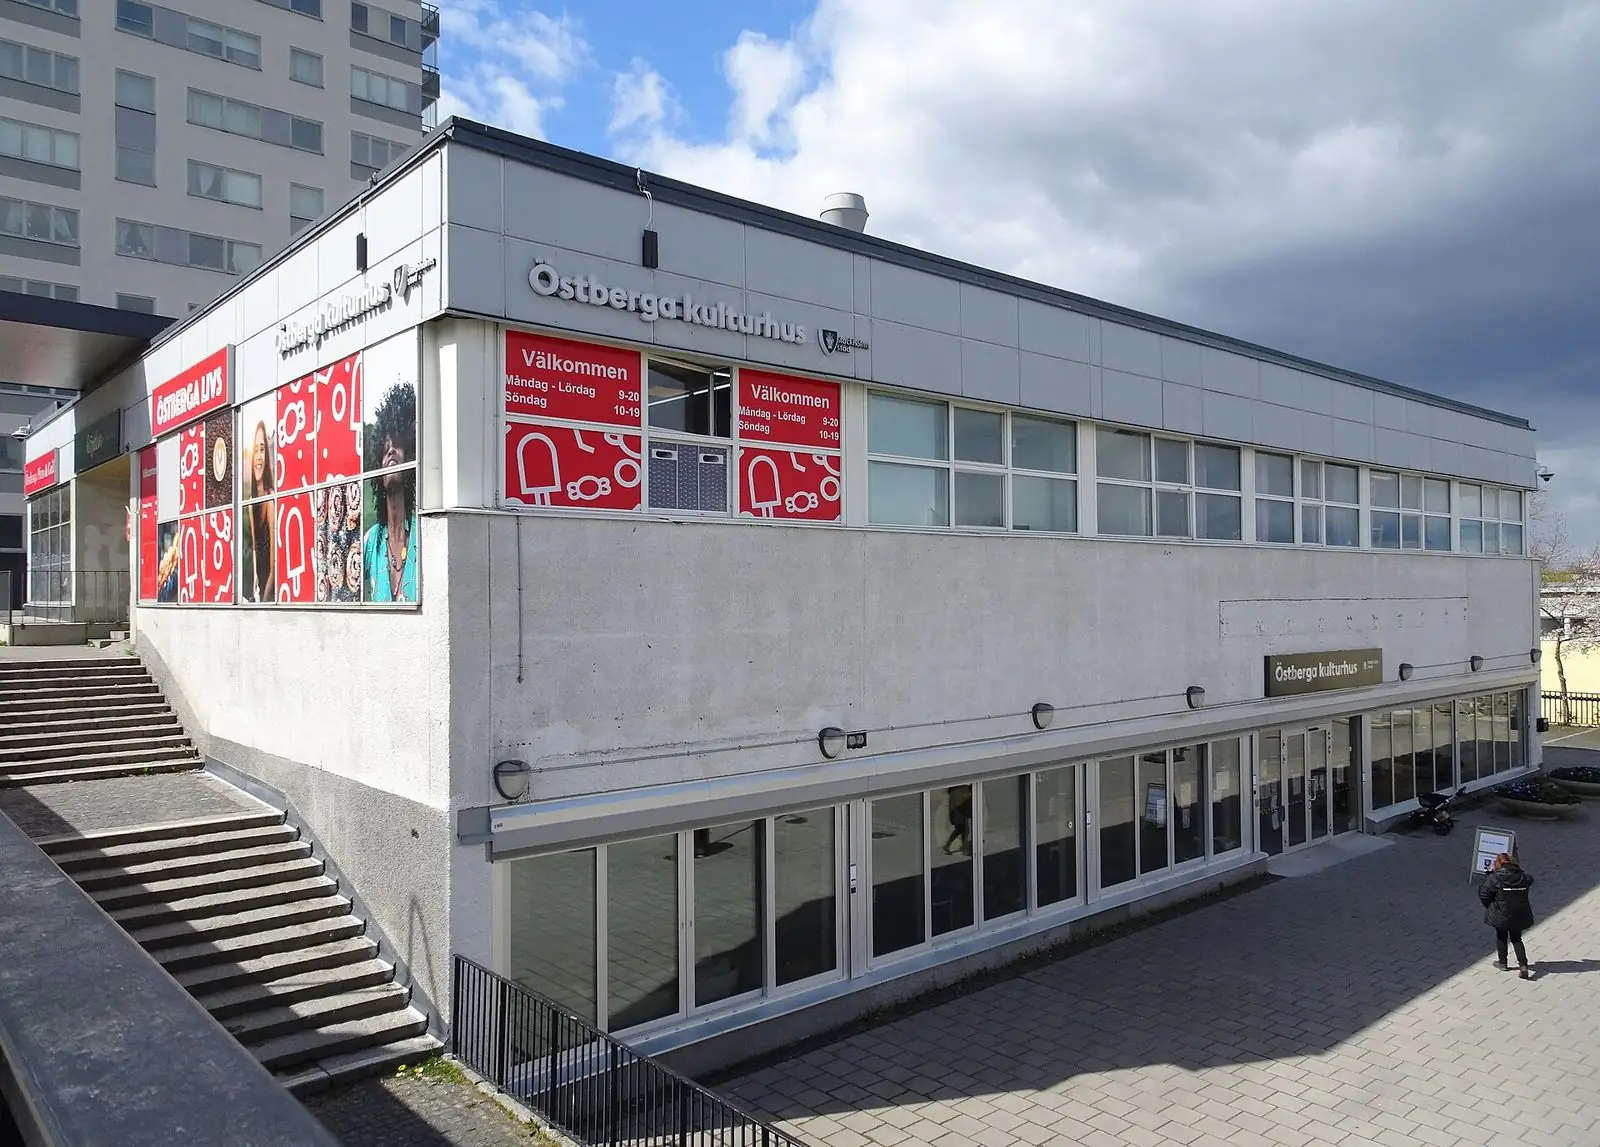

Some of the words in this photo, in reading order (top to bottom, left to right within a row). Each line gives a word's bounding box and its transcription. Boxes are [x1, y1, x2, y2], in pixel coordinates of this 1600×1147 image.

[528, 256, 677, 322] Östberga
[683, 293, 807, 345] kulturhus
[522, 348, 628, 381] Välkommen
[157, 379, 200, 426] ÖSTBERGA
[201, 366, 223, 404] LIVS
[505, 374, 549, 392] Måndag
[558, 382, 596, 399] Lördag
[618, 390, 640, 402] 9-20
[751, 383, 830, 409] Välkommen
[505, 391, 548, 409] Söndag
[614, 405, 640, 417] 10-19
[739, 406, 771, 421] Måndag
[778, 411, 806, 425] Lördag
[823, 416, 839, 427] 9-20
[739, 420, 770, 435] Söndag
[819, 430, 839, 441] 10-19
[1275, 662, 1317, 682] Östberga
[1319, 660, 1358, 678] kulturhus
